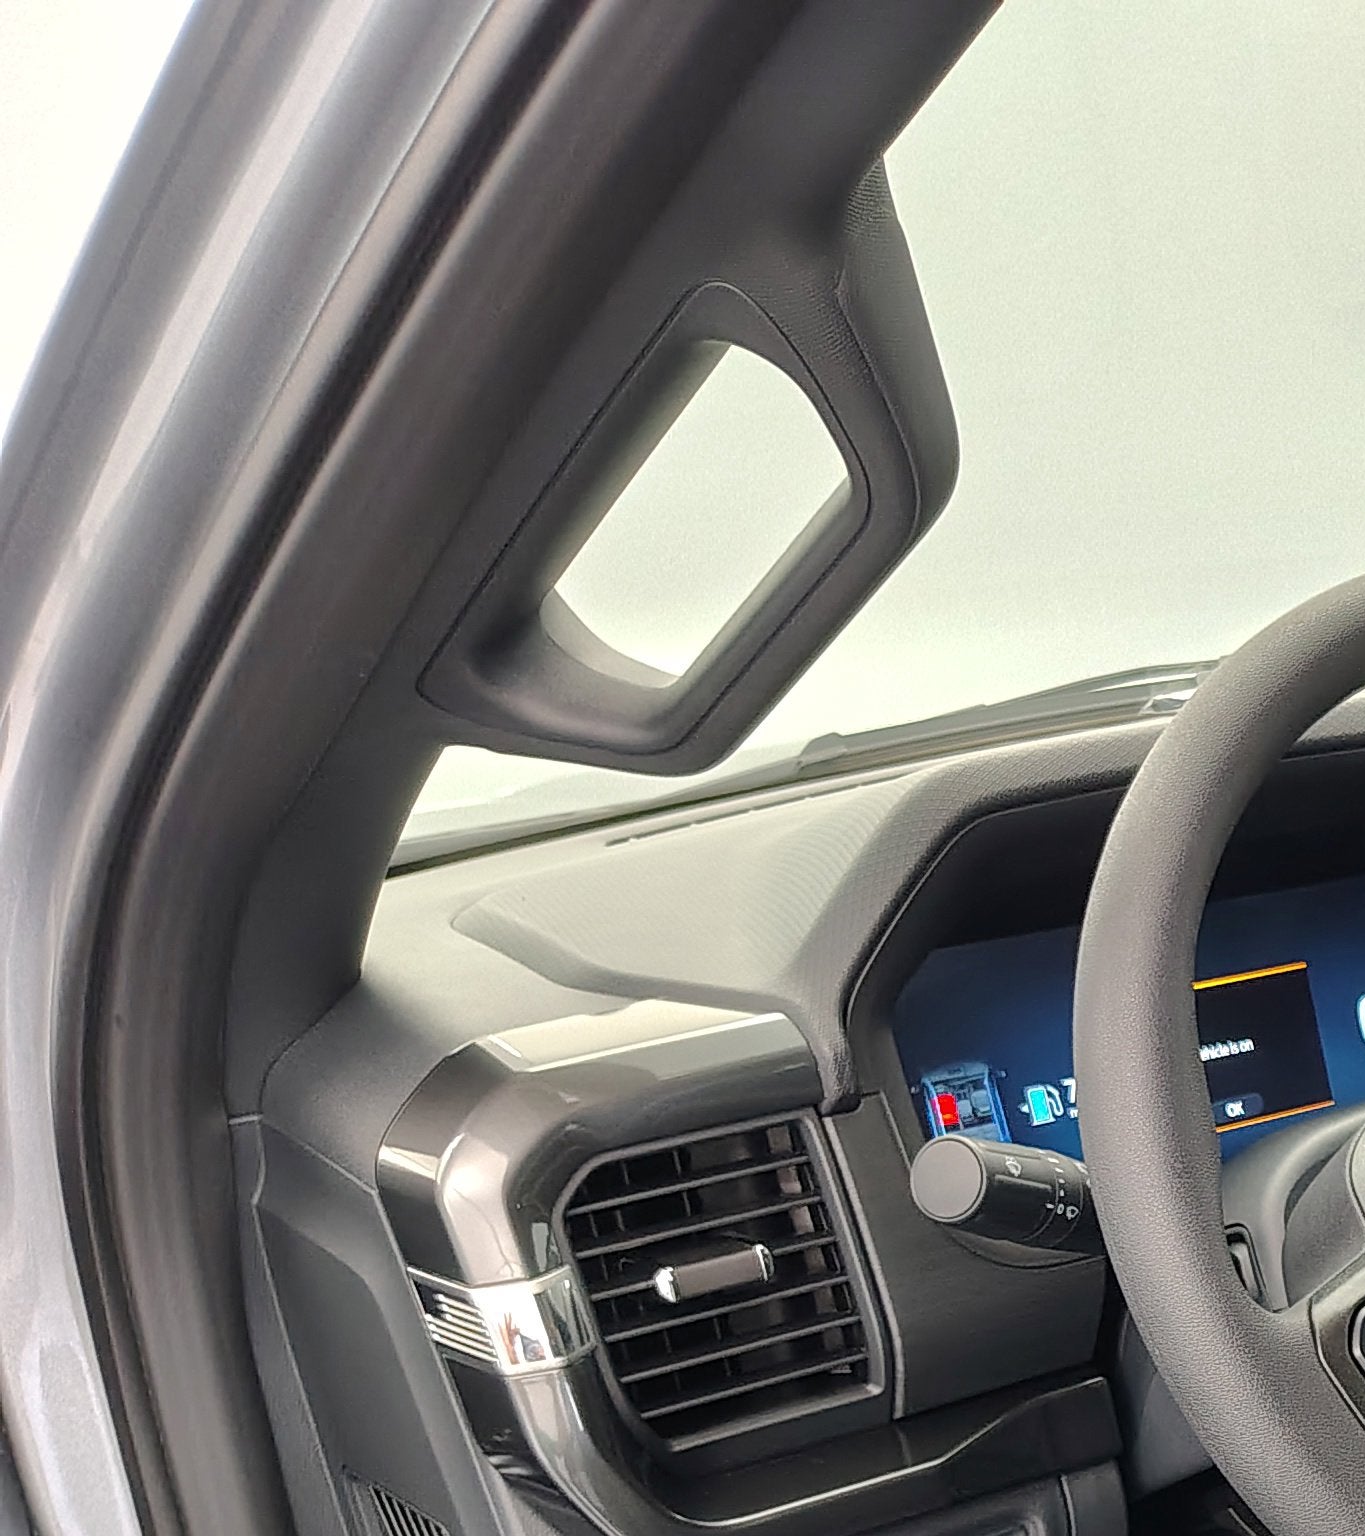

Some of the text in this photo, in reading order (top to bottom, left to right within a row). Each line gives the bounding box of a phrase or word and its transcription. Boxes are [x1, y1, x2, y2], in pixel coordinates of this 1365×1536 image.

[1199, 1038, 1255, 1062] ehicle is on
[1224, 1100, 1245, 1118] OK
